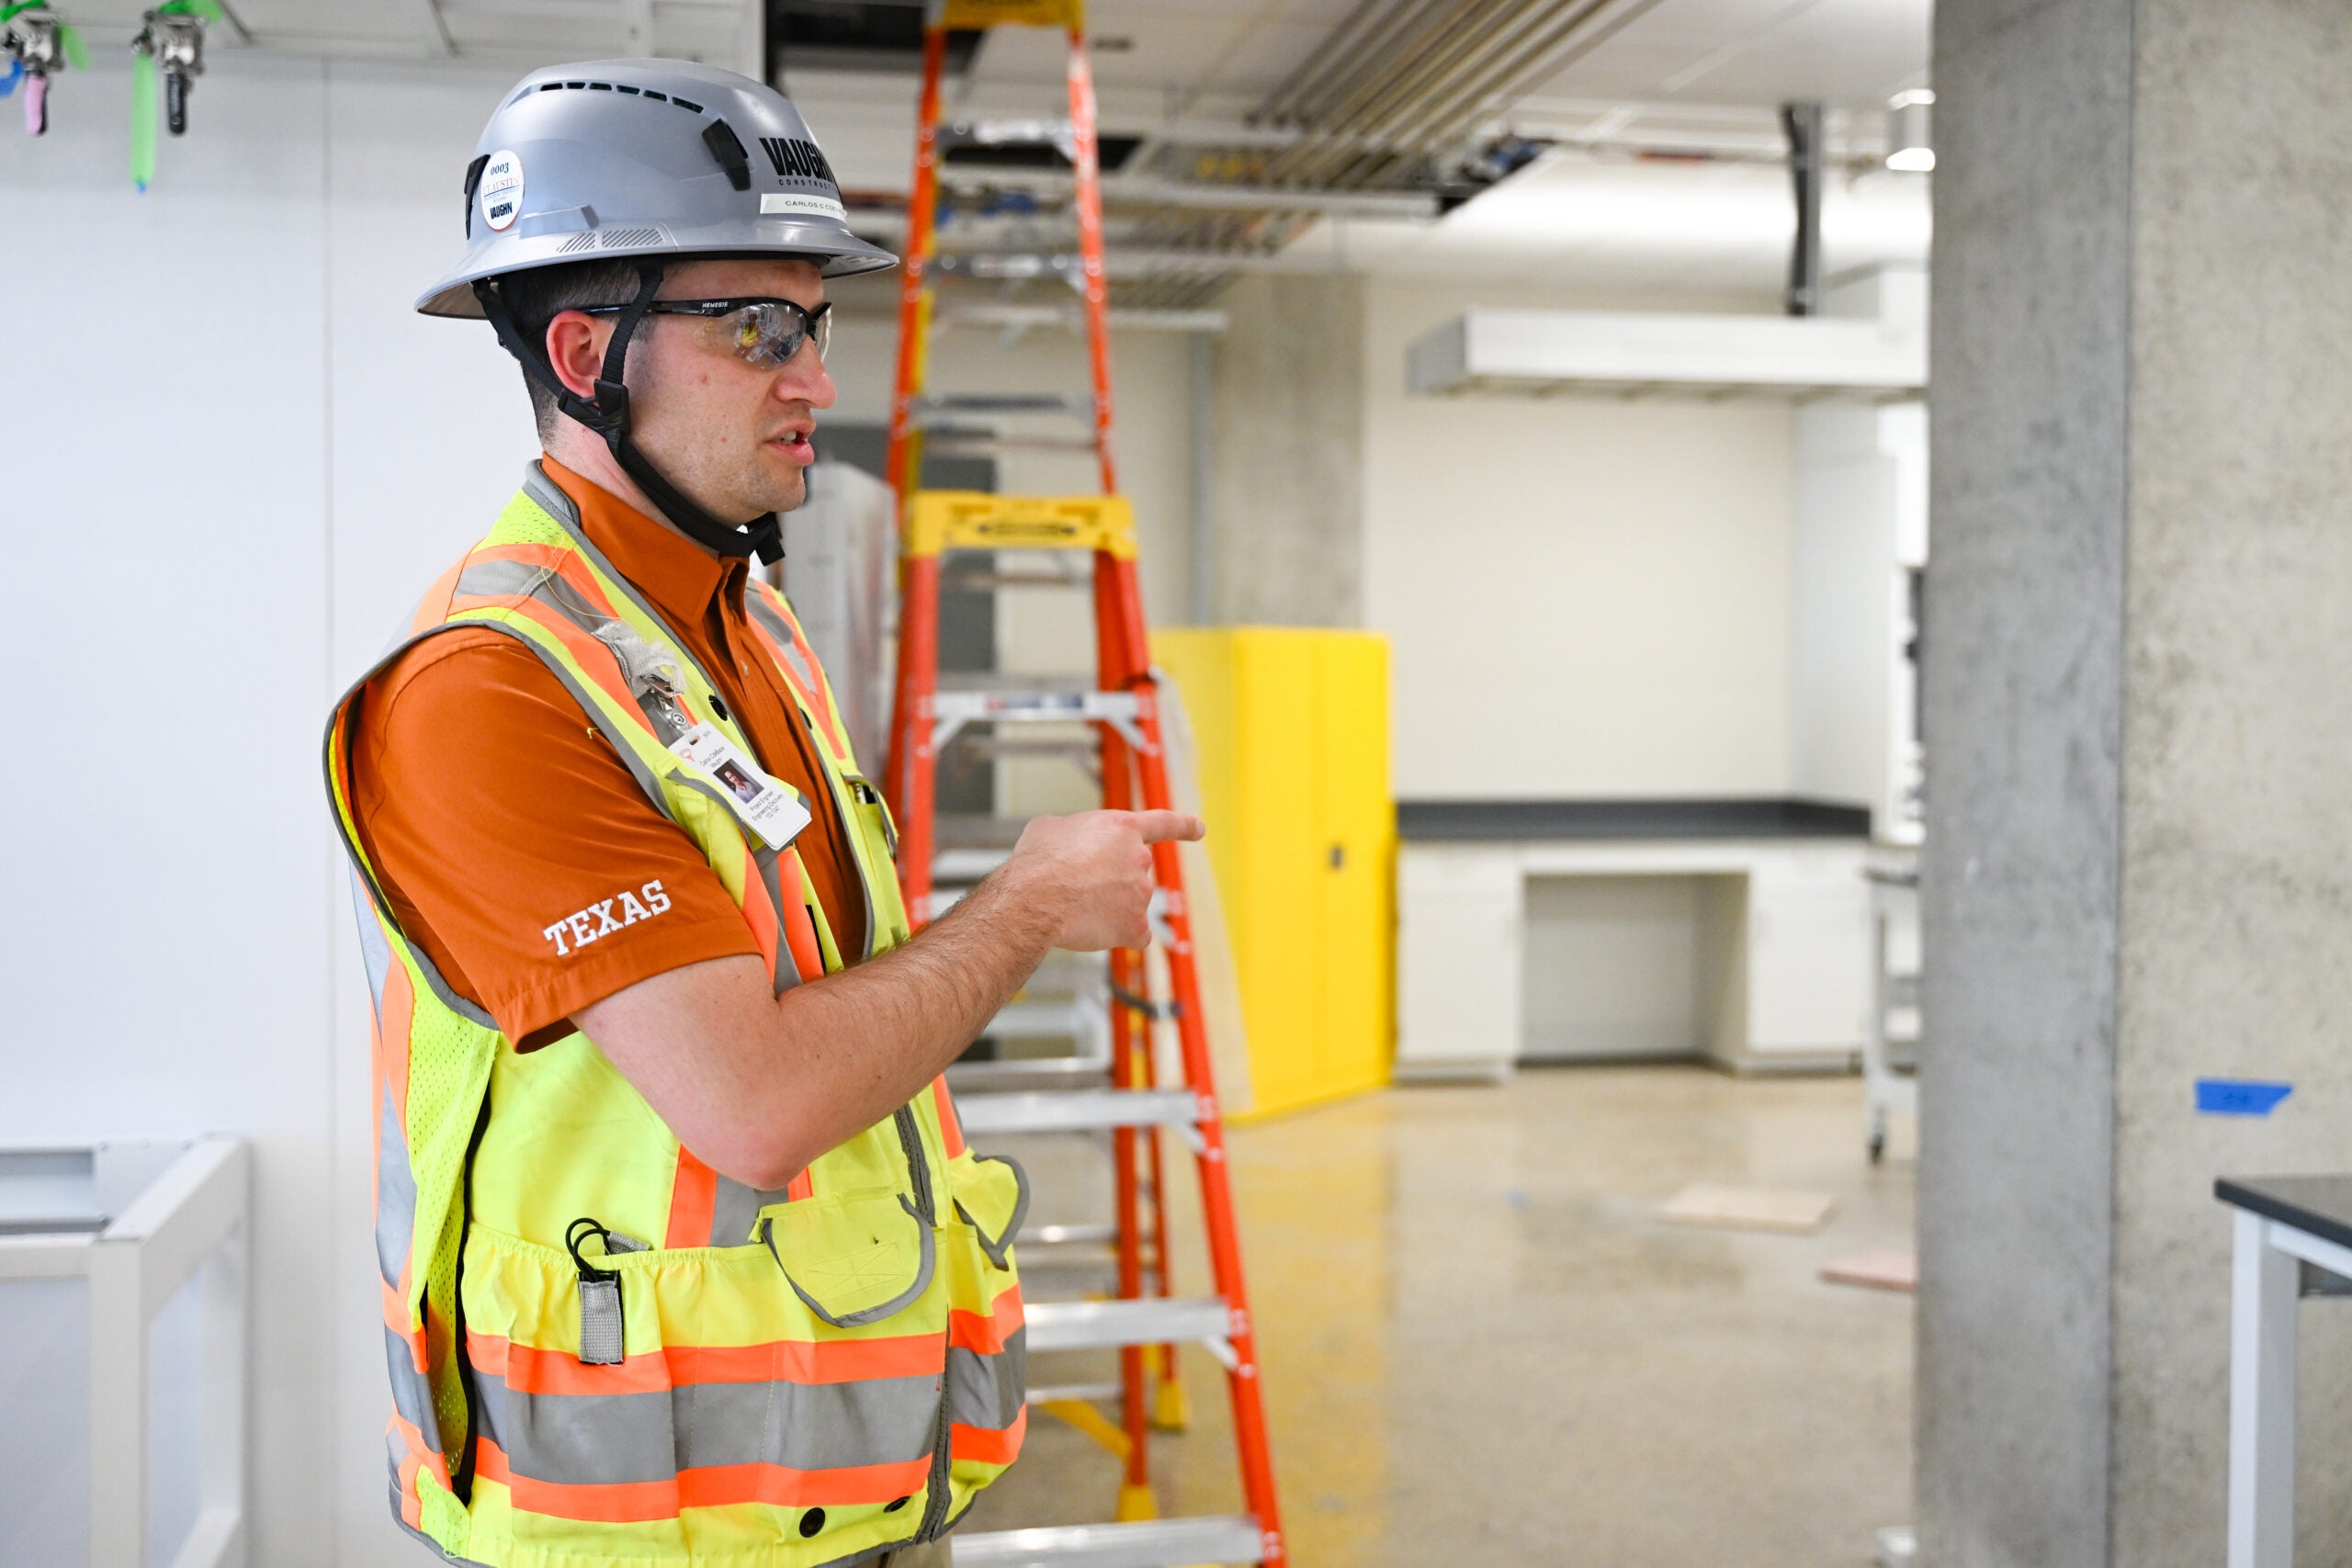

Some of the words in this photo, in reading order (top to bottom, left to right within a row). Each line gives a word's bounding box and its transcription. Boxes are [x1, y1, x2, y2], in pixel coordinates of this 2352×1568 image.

[490, 162, 509, 175] 0003
[492, 177, 519, 191] AUSTIN
[490, 201, 513, 220] VAUGHN
[786, 200, 819, 209] CARLOS
[543, 879, 672, 956] TEXAS
